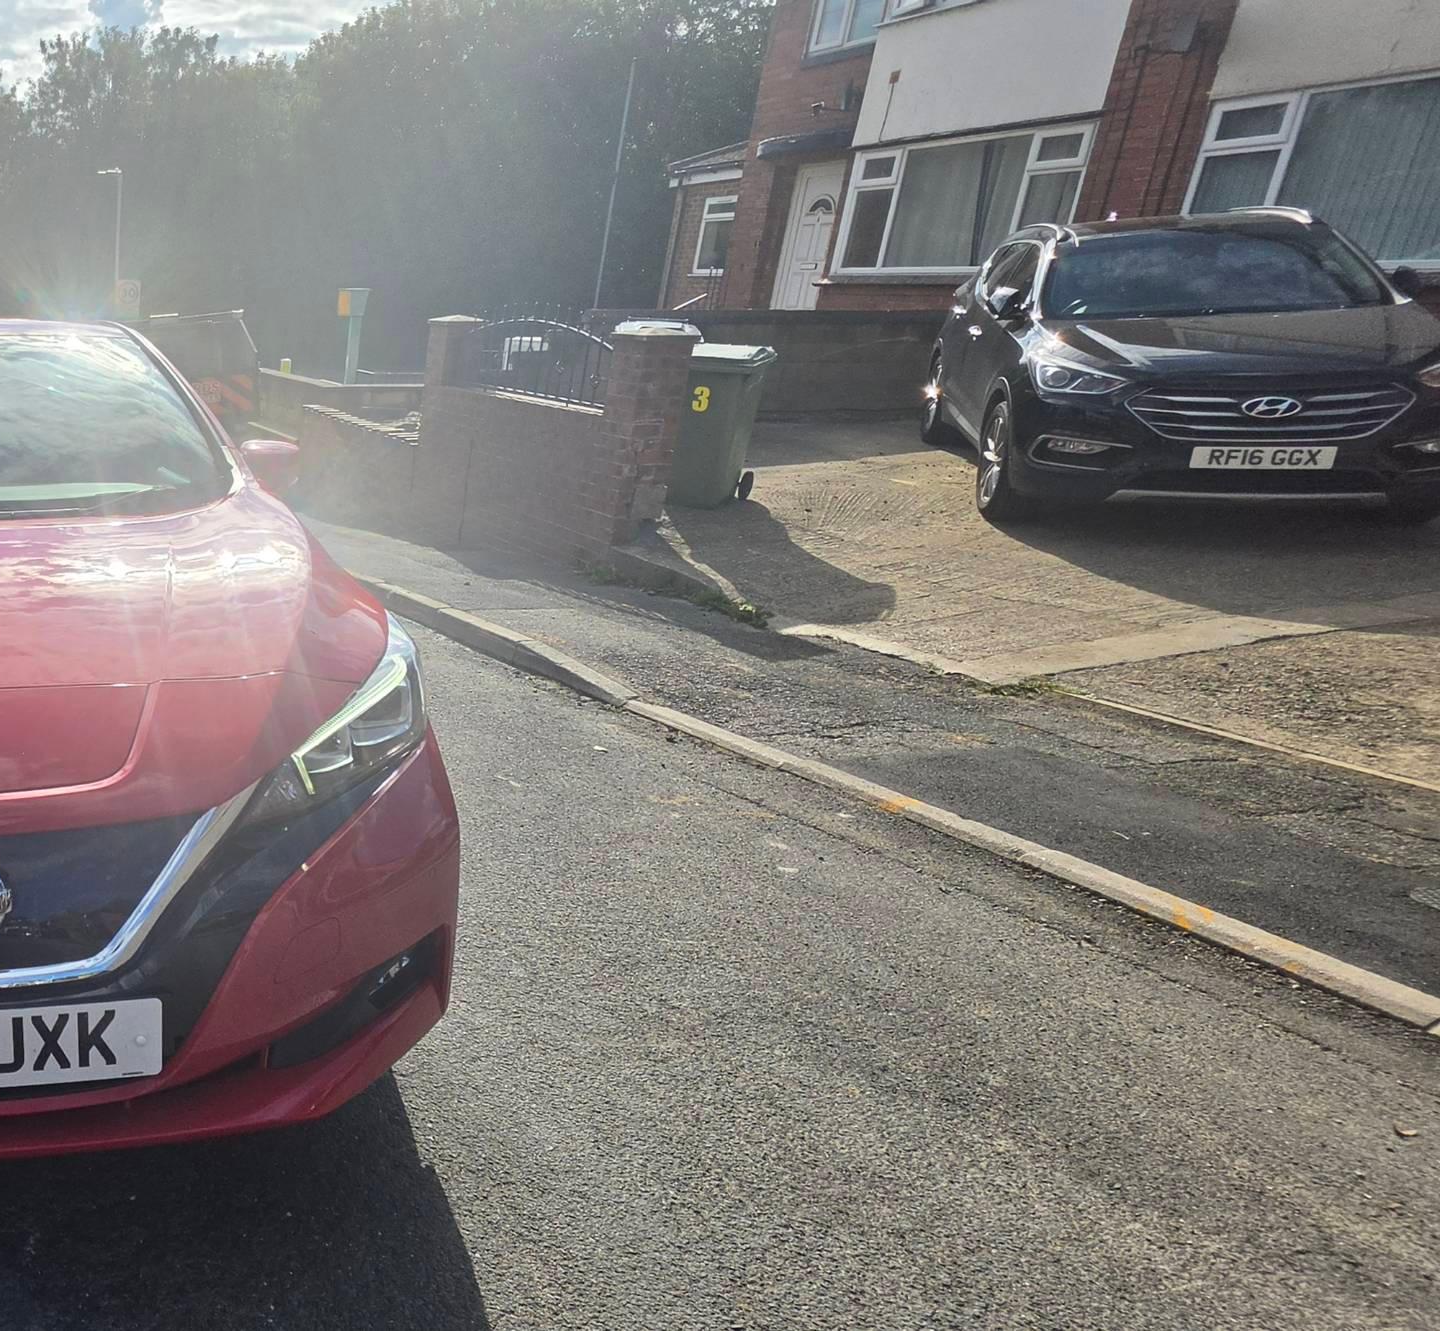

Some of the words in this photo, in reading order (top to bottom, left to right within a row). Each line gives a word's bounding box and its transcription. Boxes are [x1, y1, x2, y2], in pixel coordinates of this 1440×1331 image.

[691, 386, 711, 412] 3
[1207, 448, 1264, 466] RF16
[1270, 449, 1323, 467] GGX
